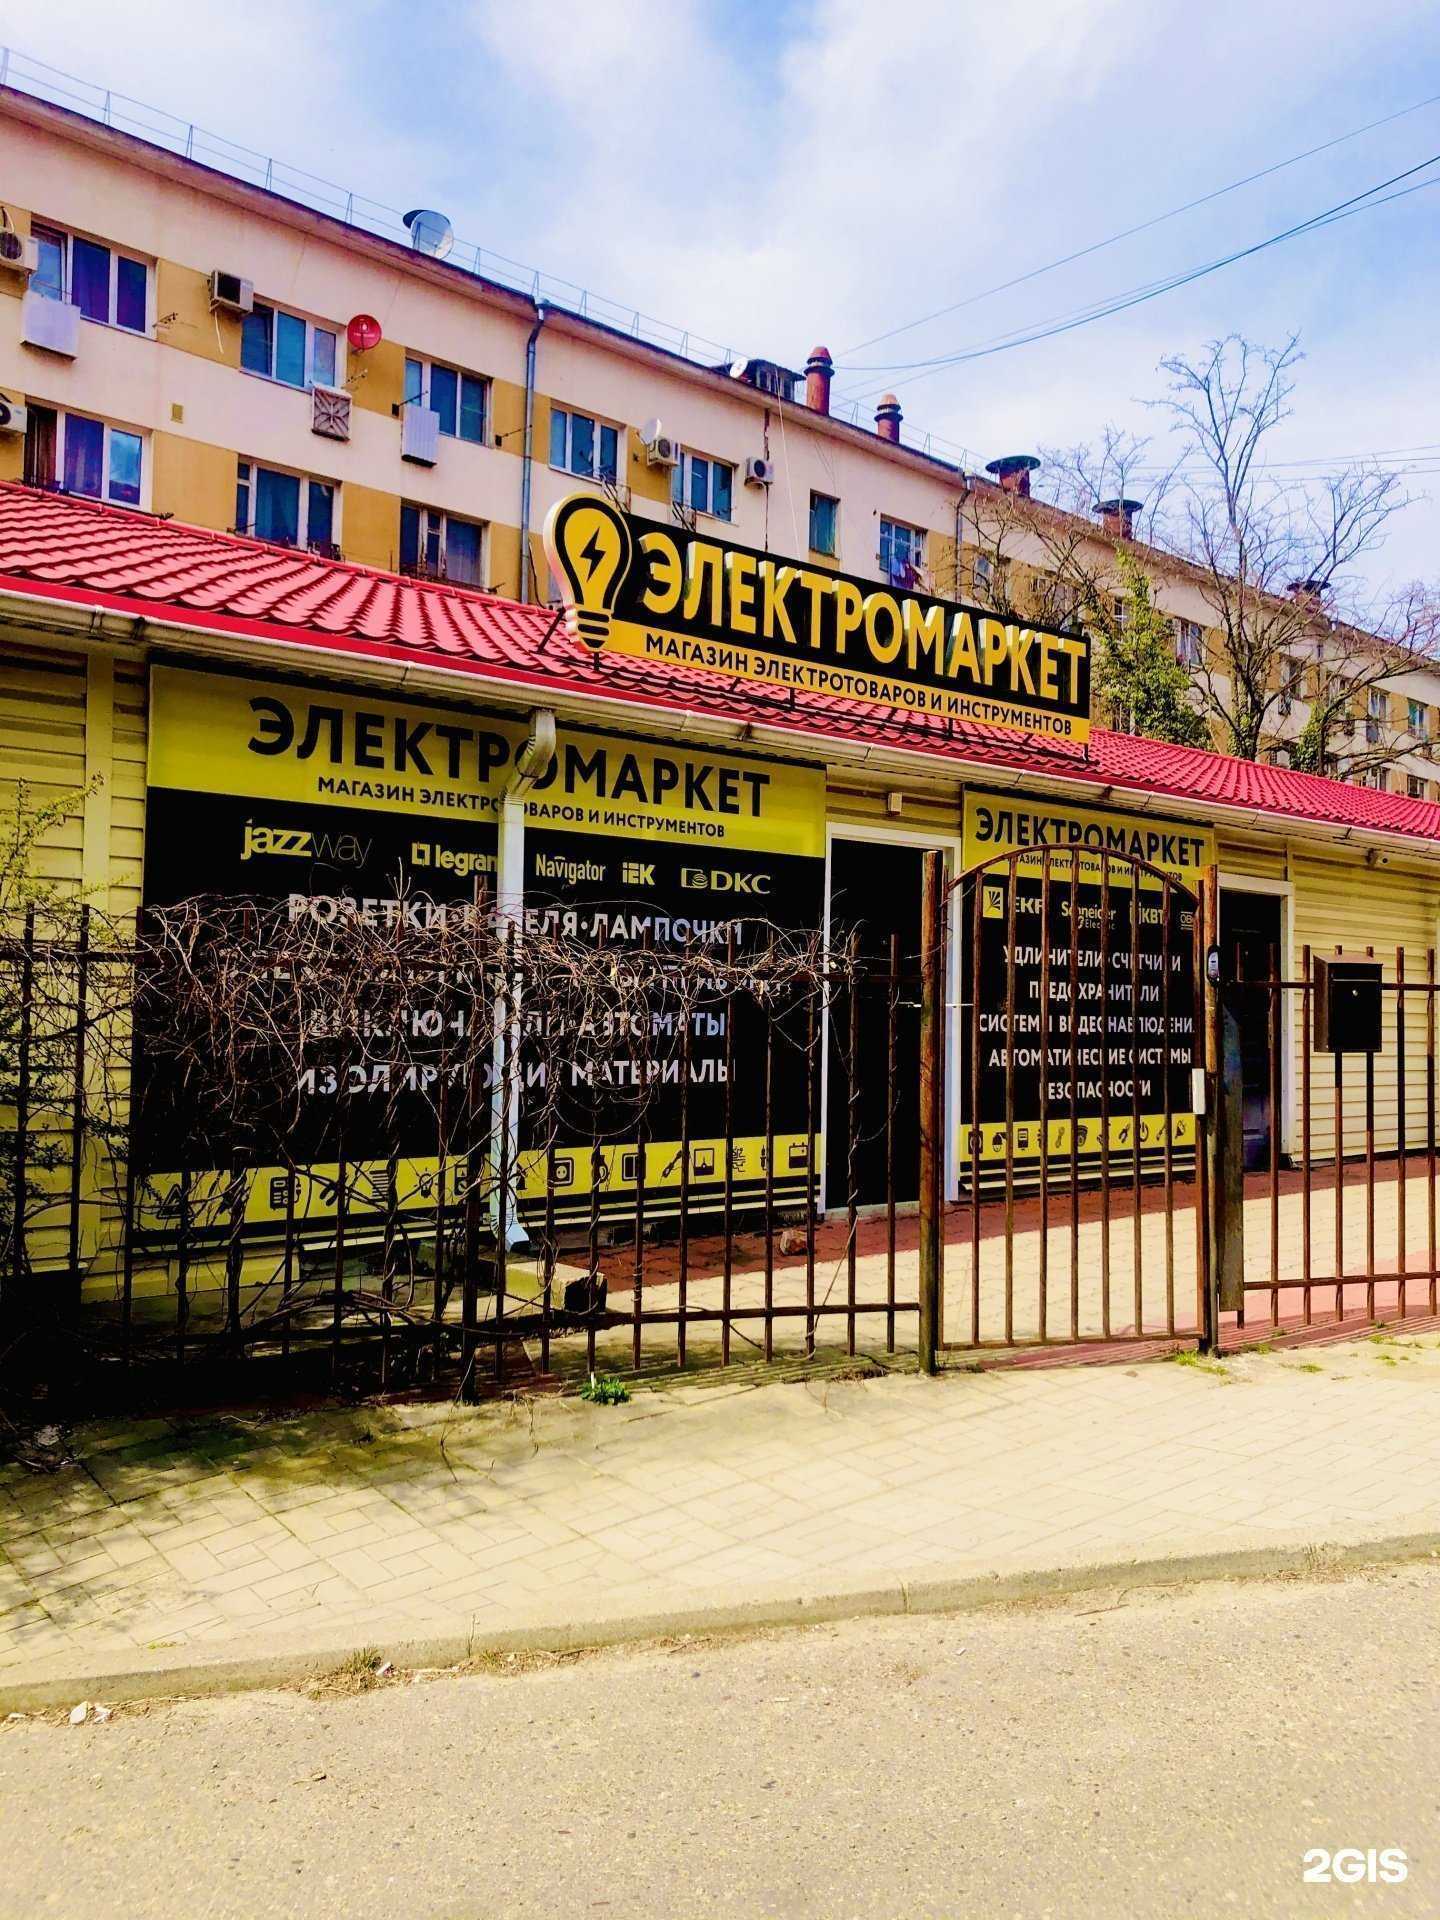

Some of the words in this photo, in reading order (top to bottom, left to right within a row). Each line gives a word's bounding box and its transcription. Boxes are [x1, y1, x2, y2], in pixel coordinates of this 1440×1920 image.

[639, 532, 1086, 704] ЭЛЕКТРОМАРКЕТ
[646, 632, 749, 672] МАГАЗИН
[753, 656, 926, 708] ЭЛЕКТРОТОВАРОВ
[931, 692, 943, 711] И
[948, 697, 1072, 736] ИНСТРУМЕНТОВ
[317, 776, 415, 803] МАГАЗИН
[419, 788, 585, 822] ЭЛЕКТРОВАРОВ
[588, 809, 600, 824] И
[604, 810, 725, 838] ИНСТРУМЕНТОВ
[975, 807, 1205, 868] ЭЛЕКТРОМАРКЕТ
[240, 819, 373, 870] jazzway
[435, 844, 498, 877] legran
[535, 853, 606, 884] Navigator
[710, 870, 771, 895] DKC
[1003, 945, 1103, 967] УДЛИНИЕЛИ
